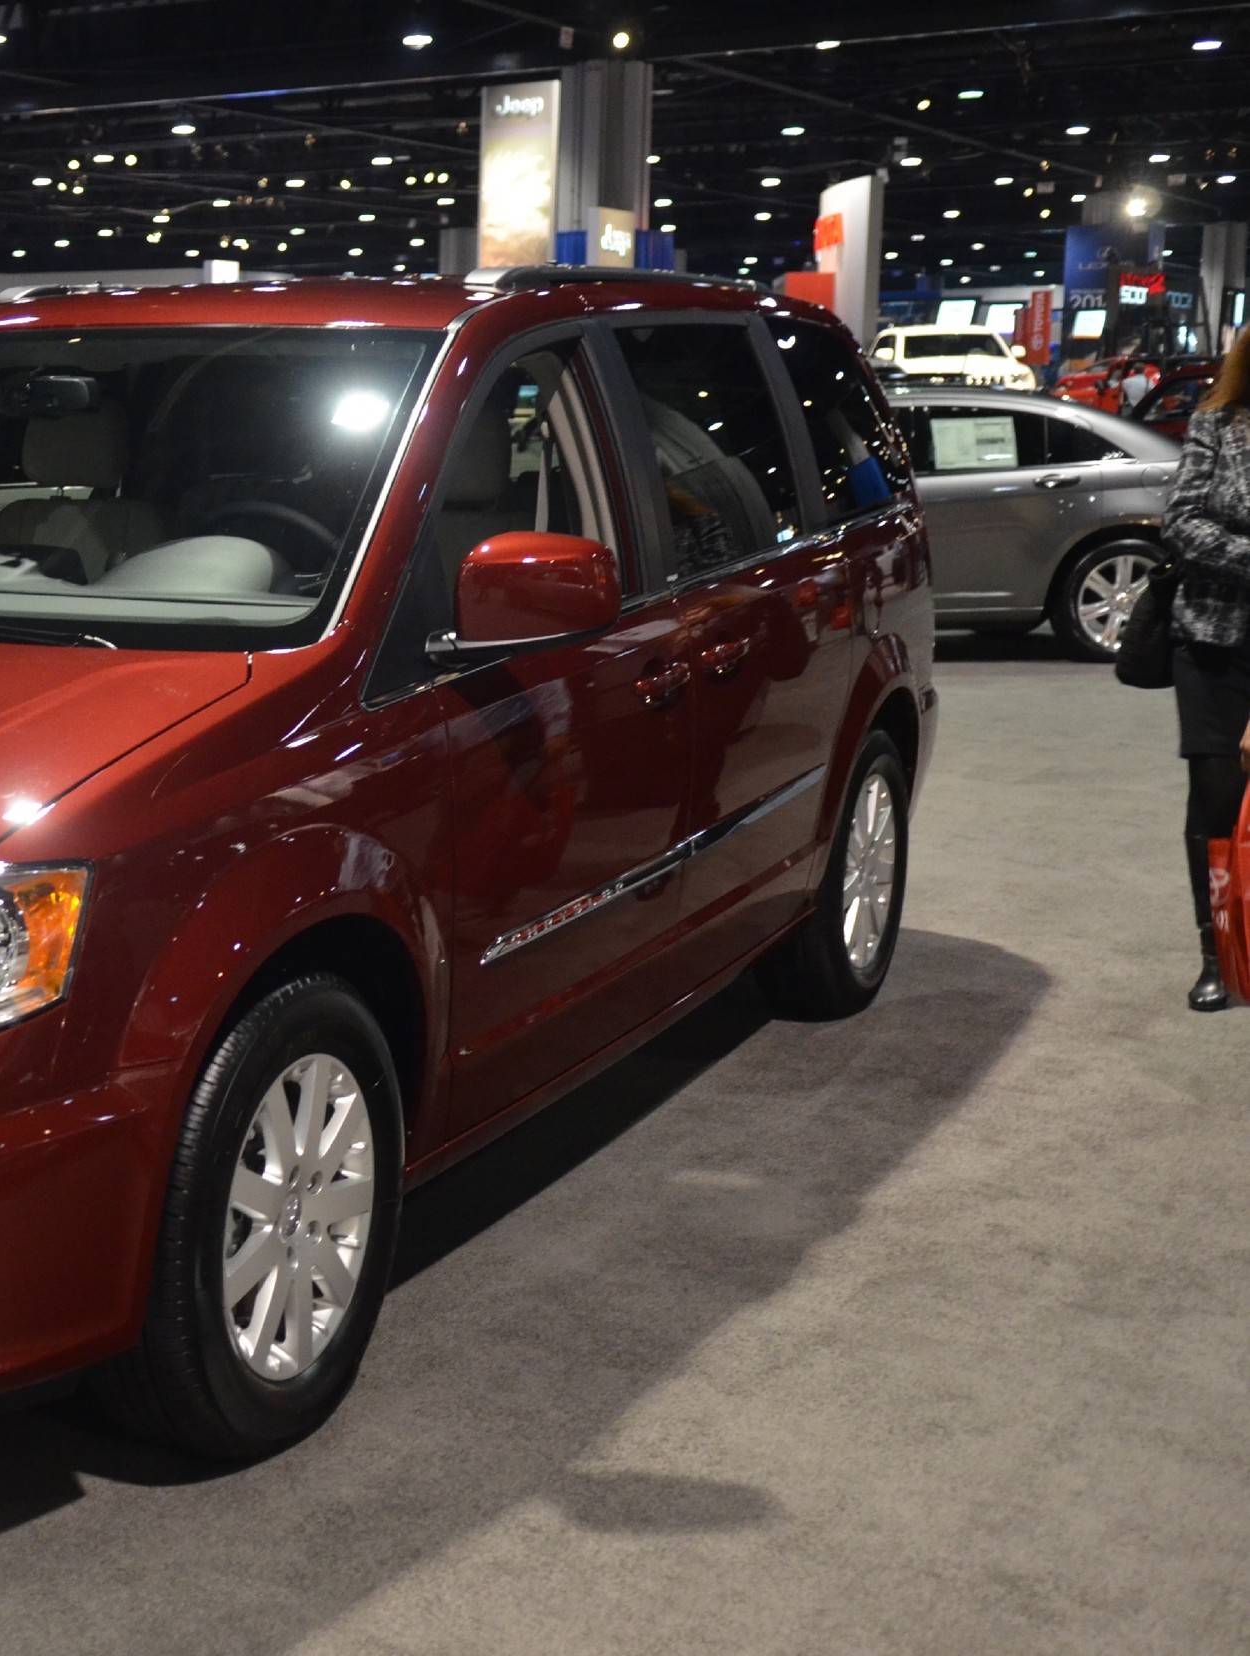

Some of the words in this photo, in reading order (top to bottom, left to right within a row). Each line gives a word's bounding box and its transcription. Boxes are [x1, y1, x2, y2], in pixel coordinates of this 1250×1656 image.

[495, 95, 544, 116] Jeep
[1070, 294, 1106, 309] 201
[510, 882, 624, 944] CHRYSLER
